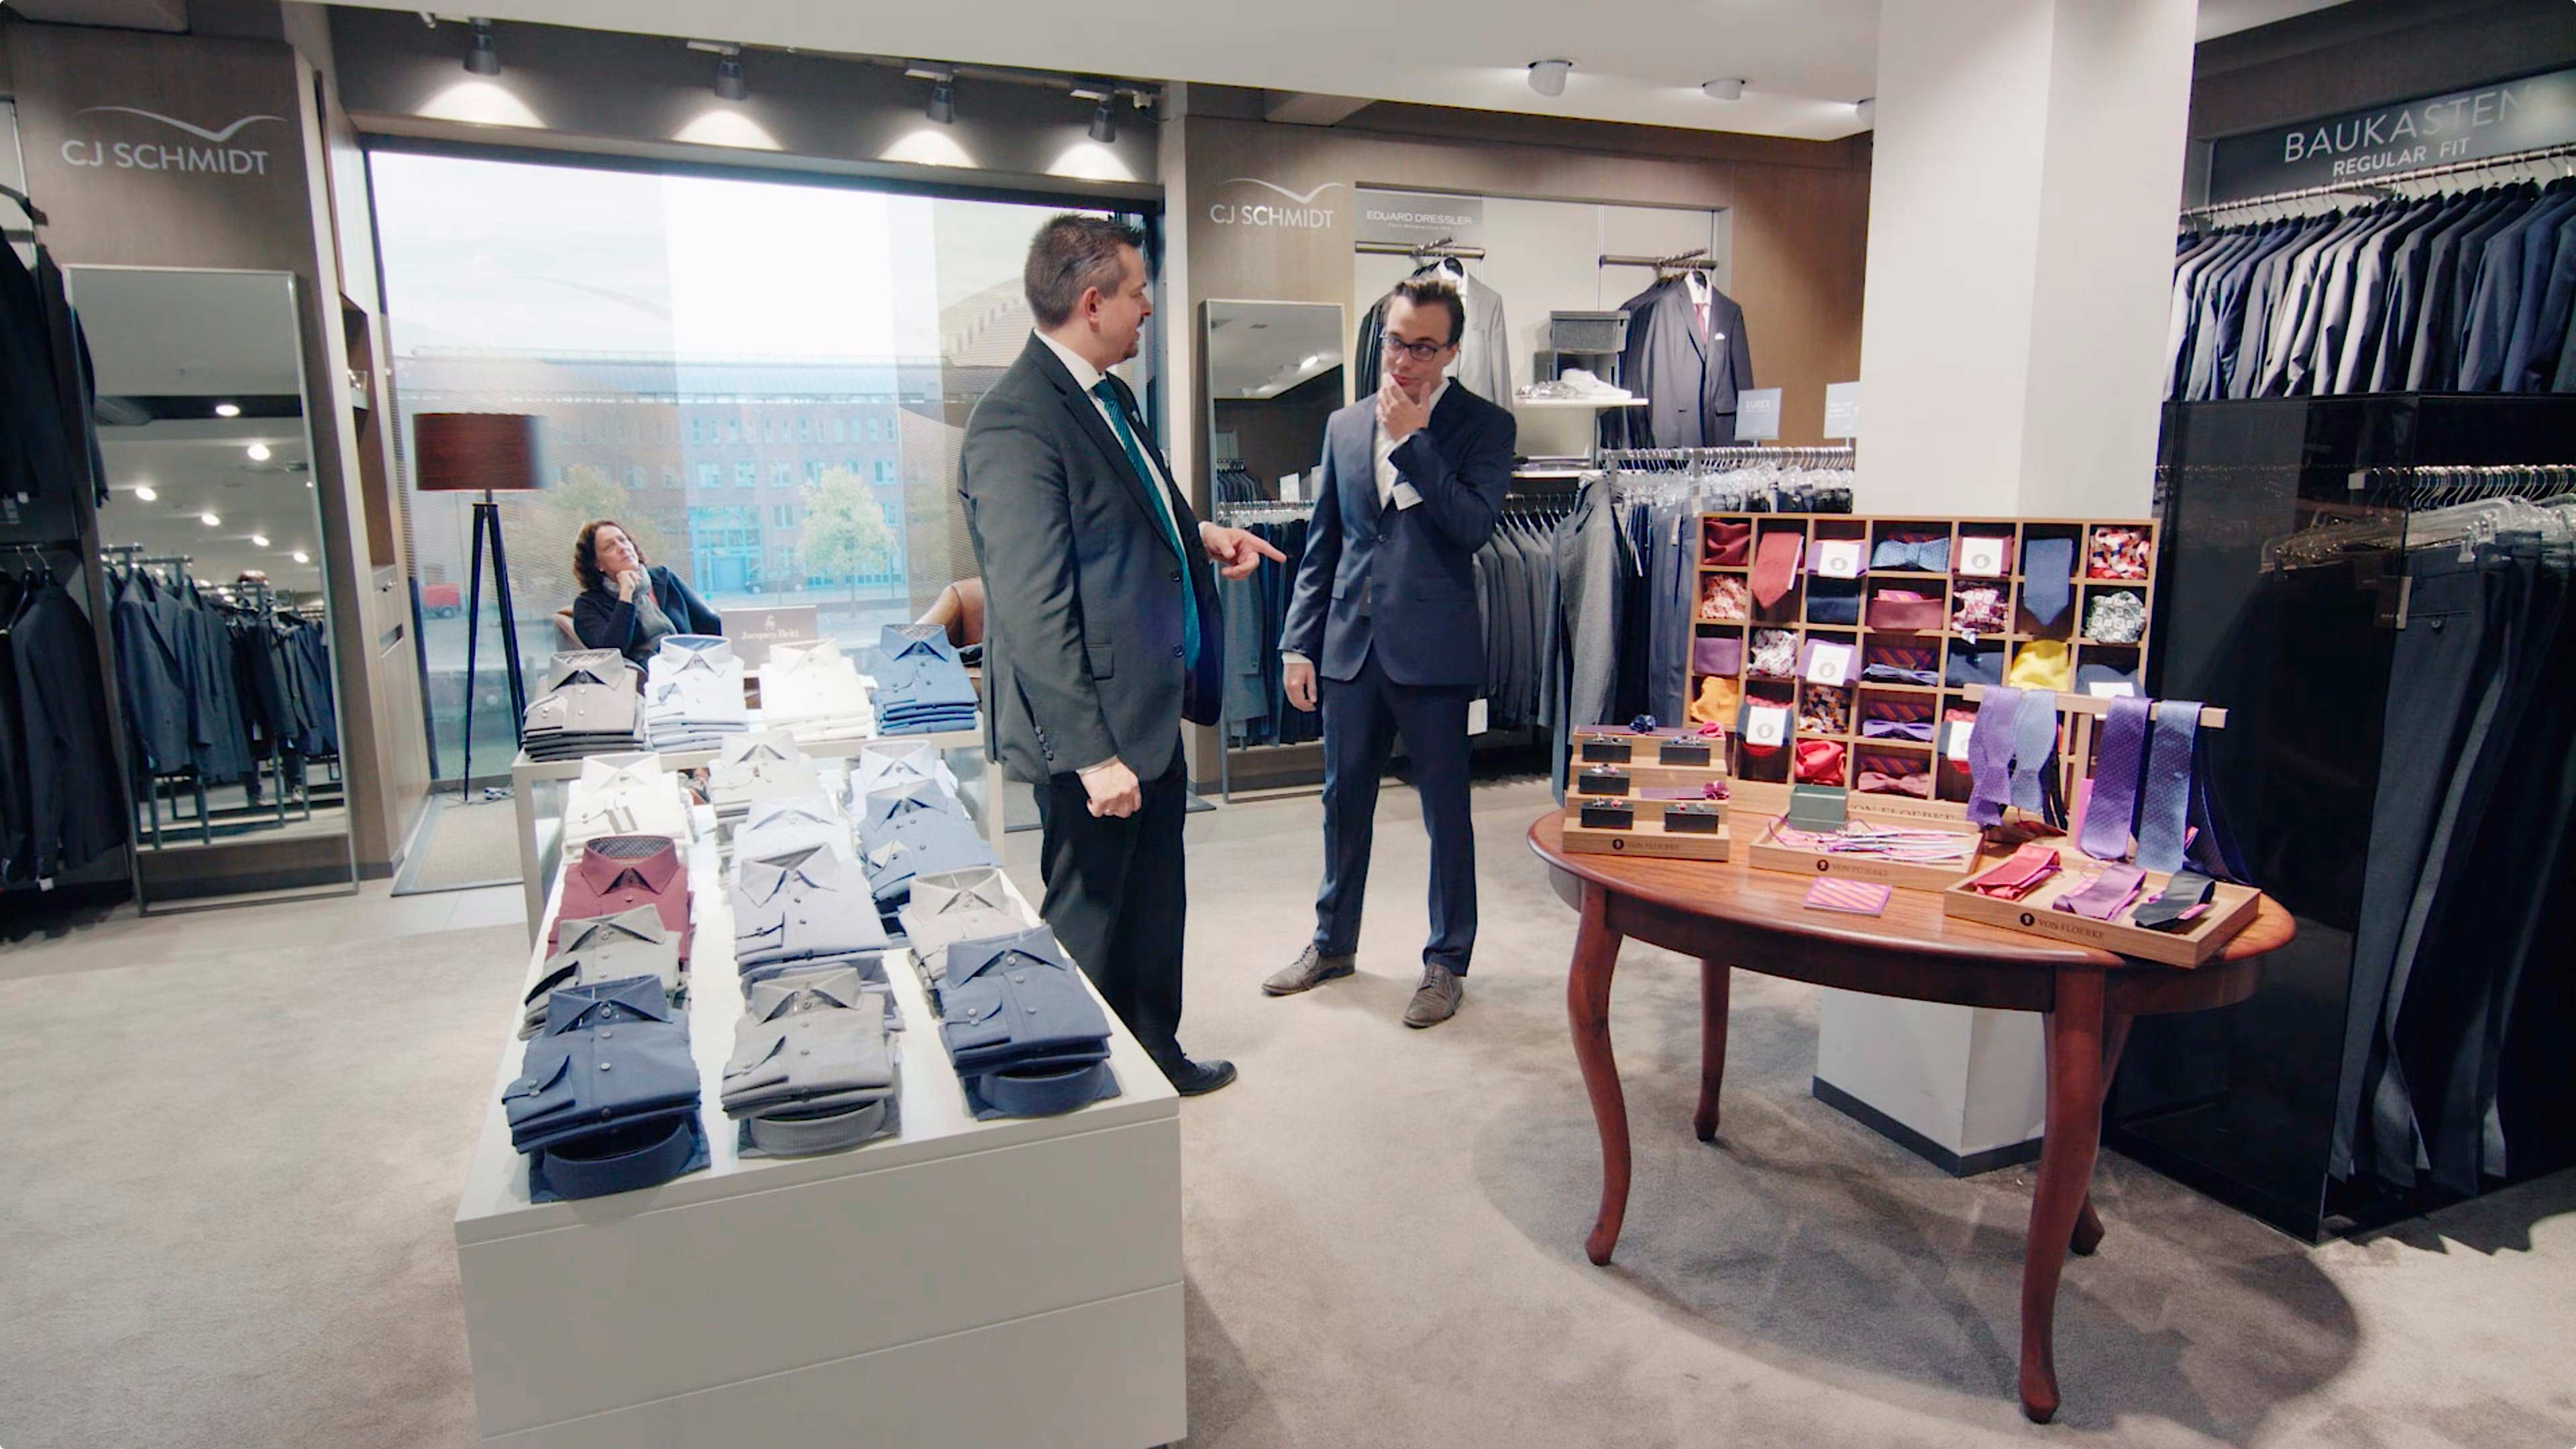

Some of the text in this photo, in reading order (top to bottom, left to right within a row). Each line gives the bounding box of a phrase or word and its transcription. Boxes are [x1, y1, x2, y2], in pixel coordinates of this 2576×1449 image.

[2284, 85, 2530, 162] BAUKASTEN
[61, 140, 268, 175] CJ SCHMIDT
[2332, 138, 2471, 177] REGULAR FIT
[1210, 204, 1334, 228] CJ SCHMIDT
[1366, 210, 1472, 225] EDUARD DRESSLER
[741, 629, 799, 641] Jacques Britt
